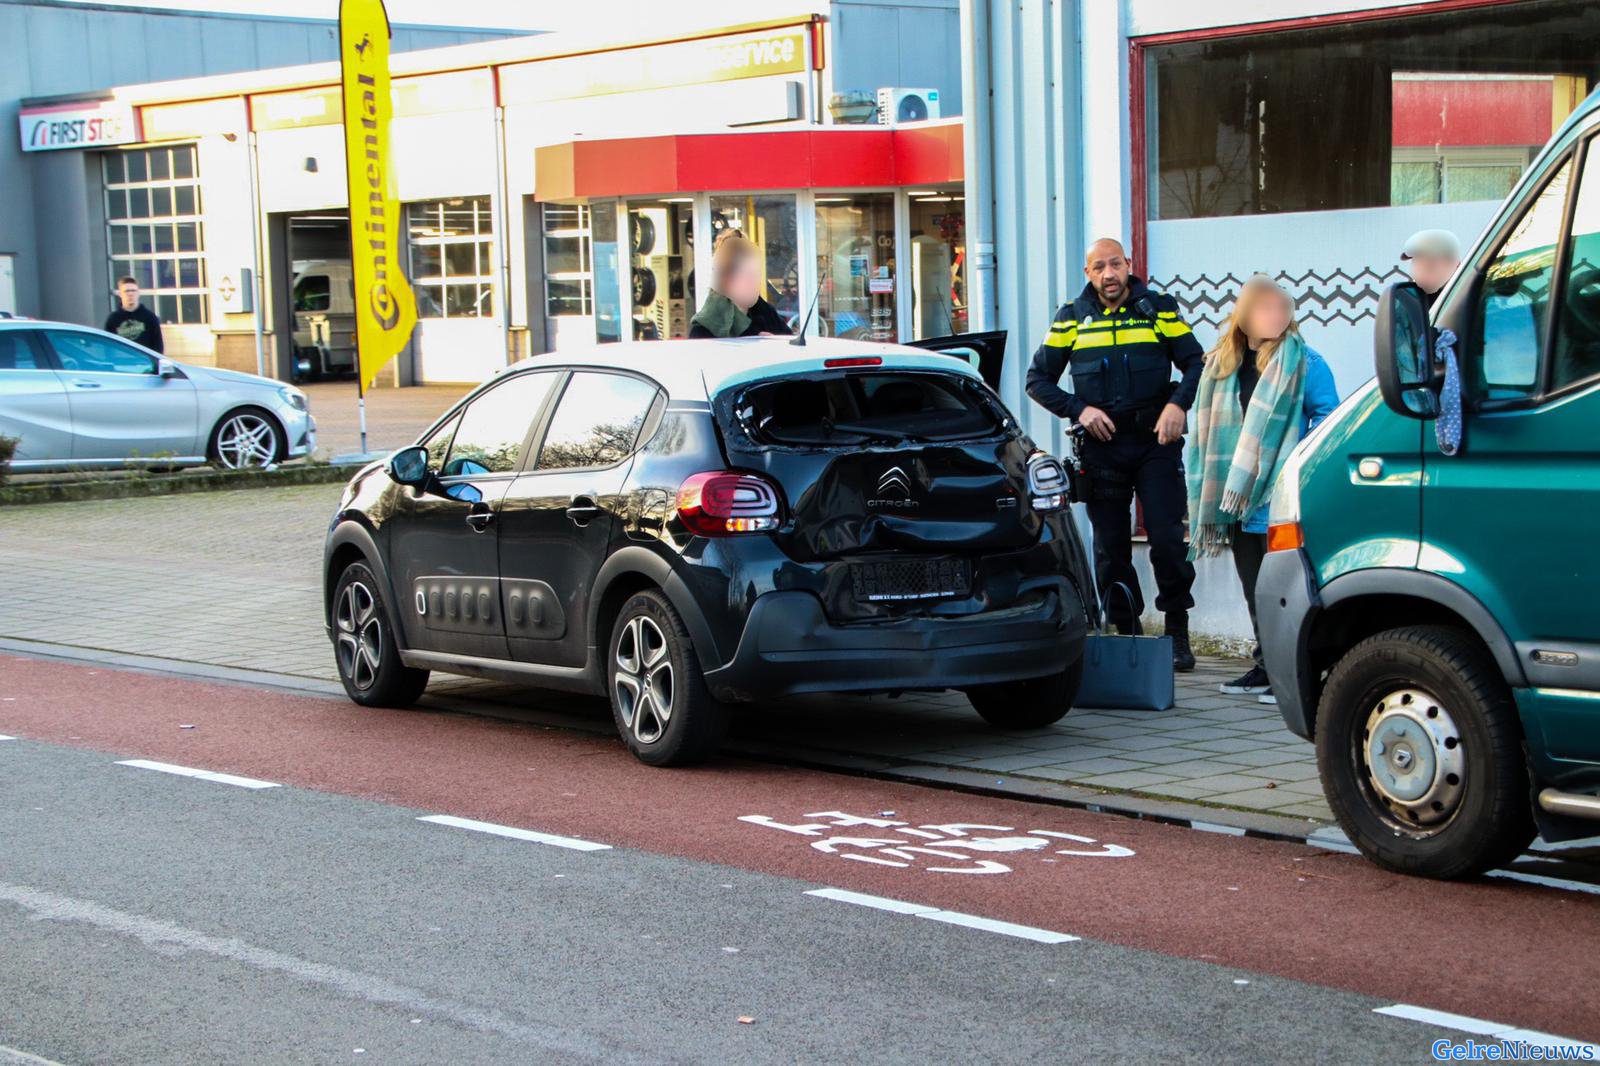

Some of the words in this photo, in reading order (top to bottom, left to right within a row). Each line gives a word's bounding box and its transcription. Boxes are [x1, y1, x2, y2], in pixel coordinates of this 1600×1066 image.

[50, 120, 86, 145] FIRST
[88, 117, 120, 142] ST
[357, 73, 400, 331] Continental
